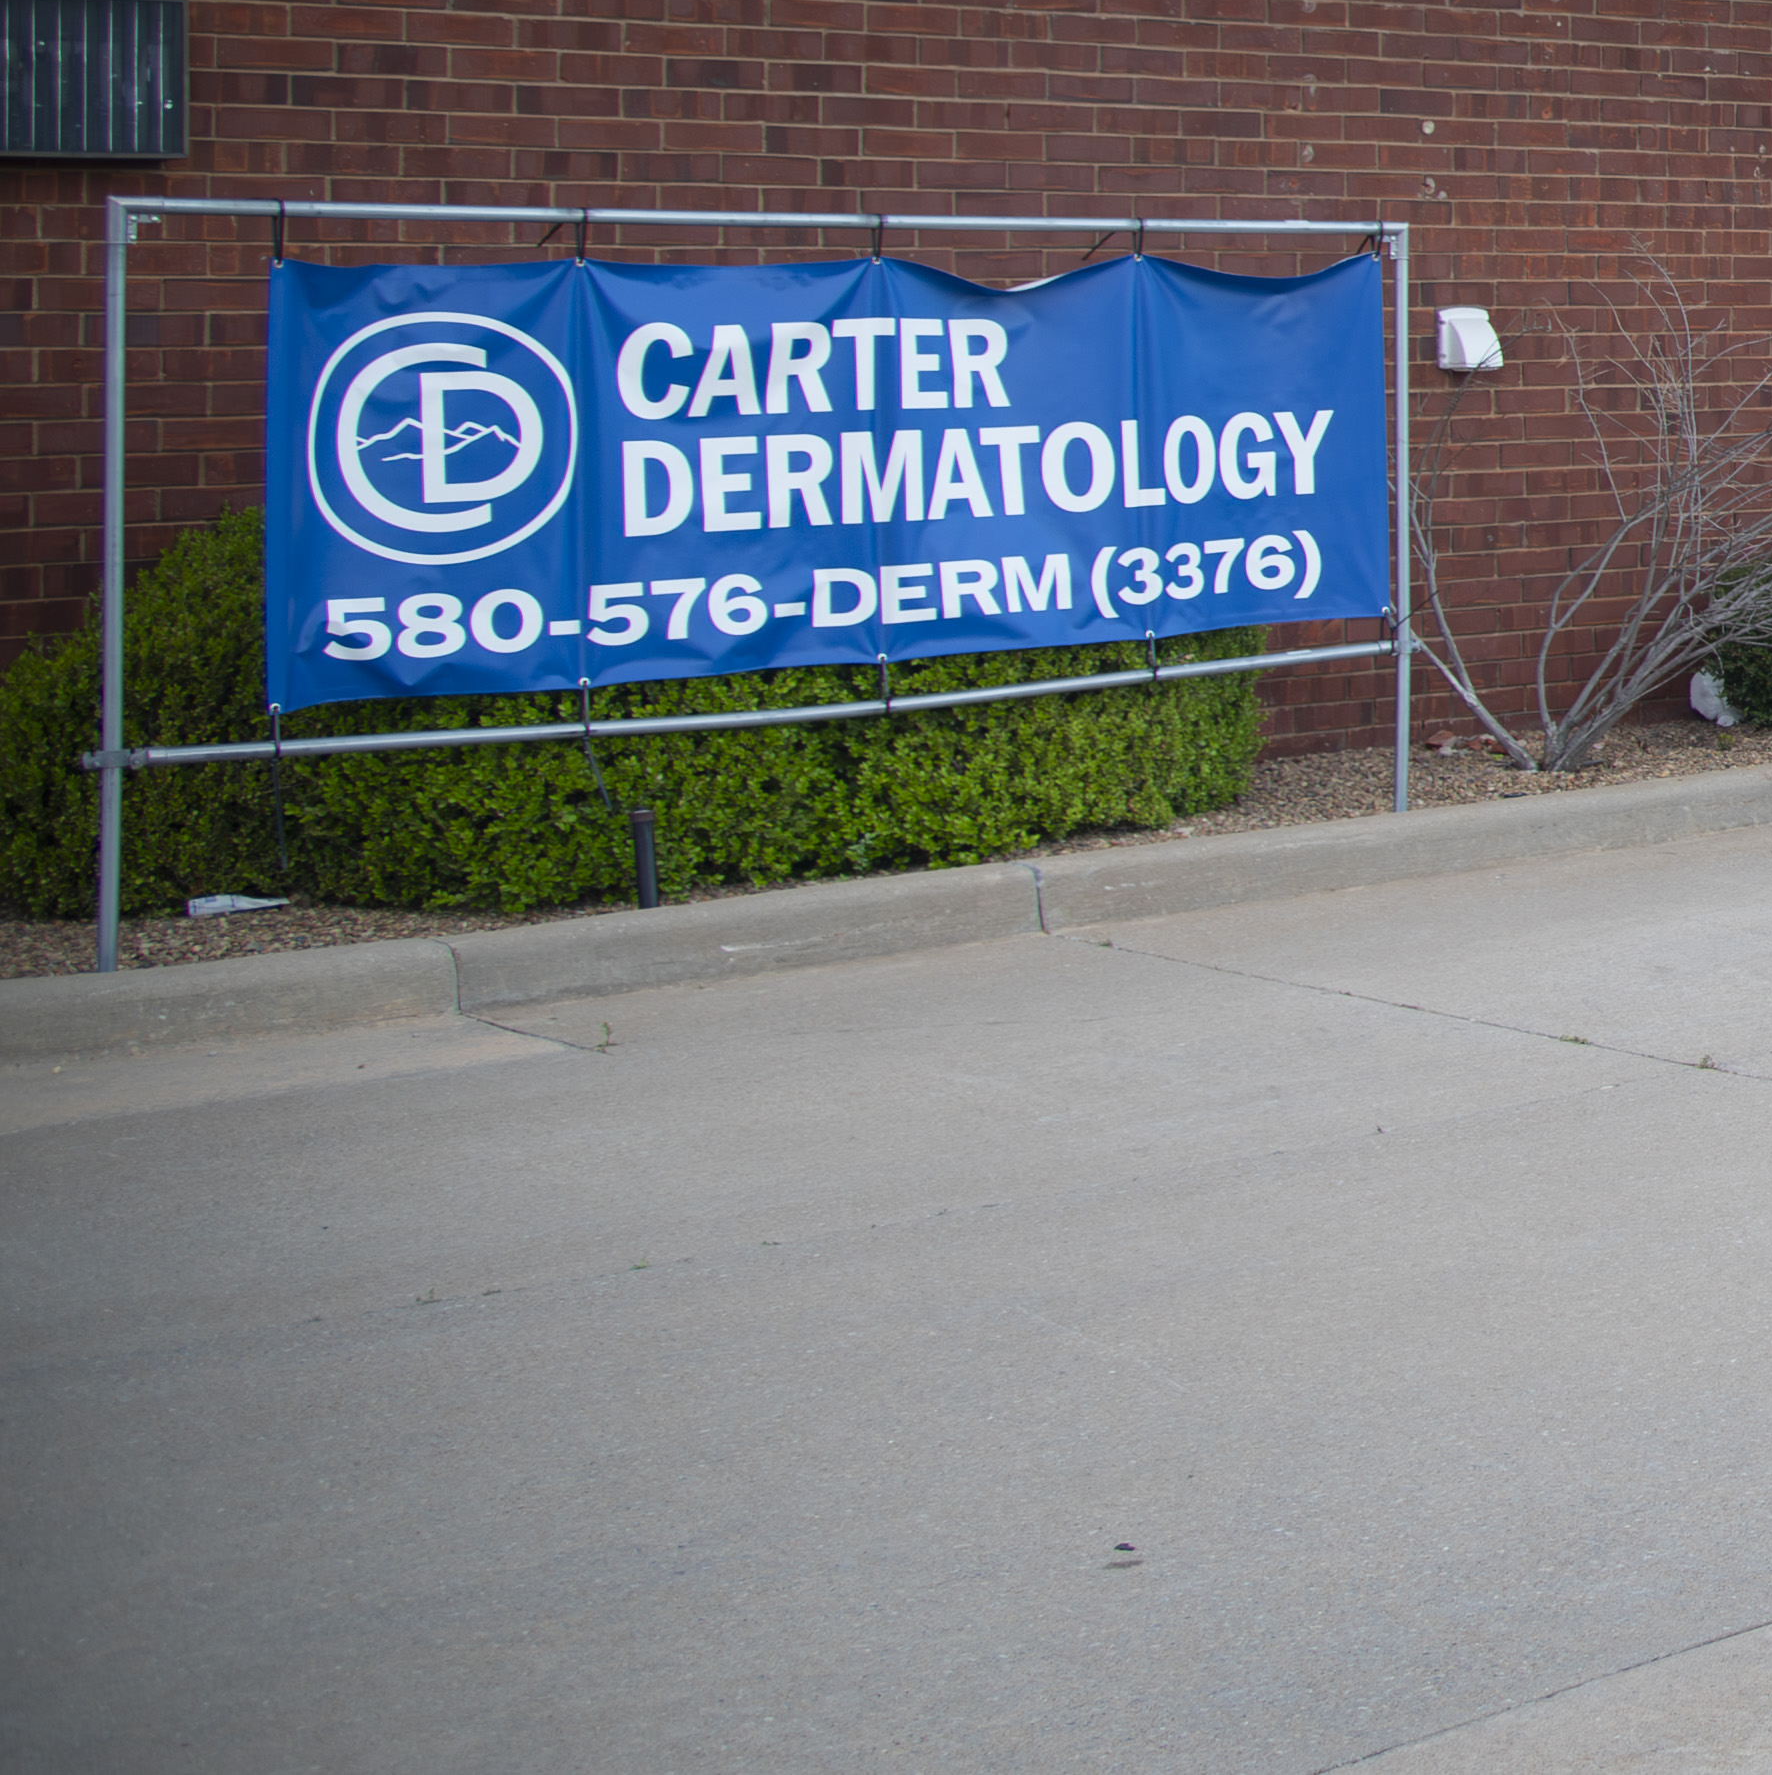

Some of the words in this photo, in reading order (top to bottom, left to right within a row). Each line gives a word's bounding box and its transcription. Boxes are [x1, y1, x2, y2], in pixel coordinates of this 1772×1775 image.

[617, 317, 1011, 420] CARTER
[622, 409, 1334, 538] DERMATOLOGY
[323, 553, 1073, 661] 580-576-DERM
[1091, 530, 1321, 619] (3376)
